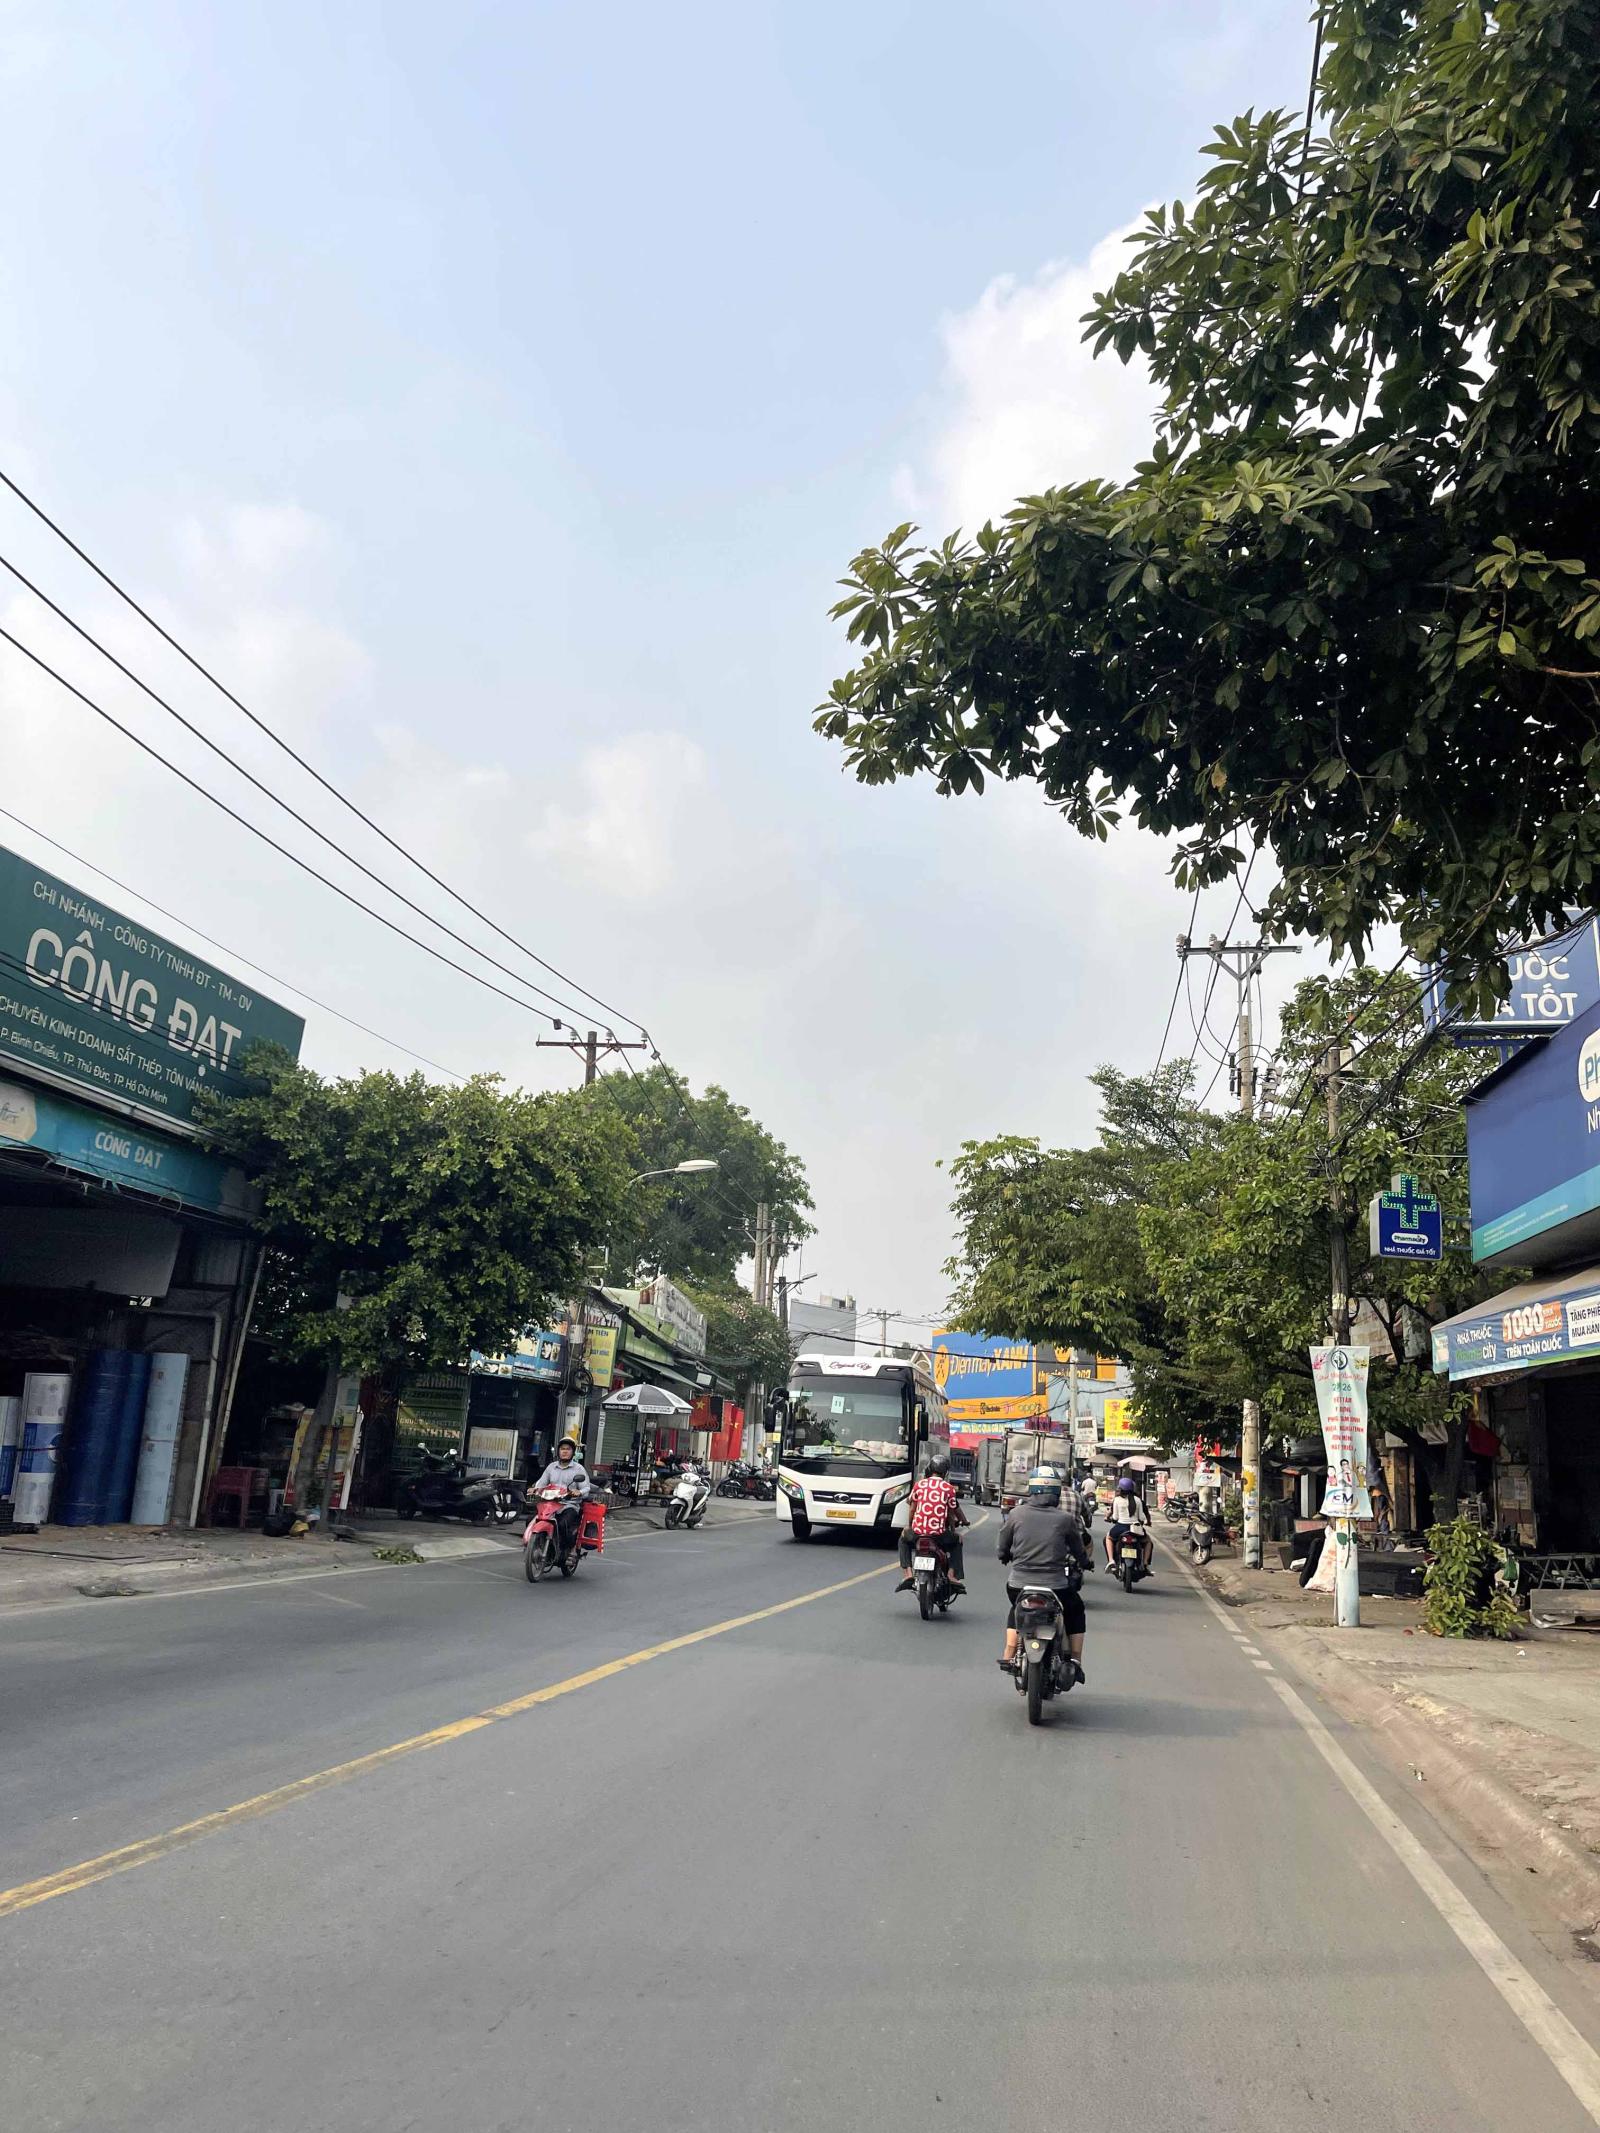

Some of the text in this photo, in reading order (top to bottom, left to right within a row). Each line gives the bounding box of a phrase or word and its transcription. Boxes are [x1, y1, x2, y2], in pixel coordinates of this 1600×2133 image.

[33, 881, 56, 905] CHI
[59, 895, 104, 931] NHÁNH
[114, 925, 147, 954] CÔNG
[150, 944, 164, 962] TY
[166, 953, 194, 981] TNHH
[196, 970, 211, 989] ĐT
[218, 982, 232, 1001] TM
[25, 928, 242, 1077] CÔNG ĐẠT
[1521, 982, 1578, 1018] TỐT
[49, 1017, 77, 1041] KINH
[78, 1030, 116, 1058] DOANH
[116, 1044, 136, 1065] SẮT
[137, 1055, 163, 1081] THÉP,
[165, 1067, 184, 1087] TÔN
[63, 1052, 75, 1067] TP.
[77, 1058, 92, 1074] Thủ
[94, 1065, 111, 1084] Đức,
[114, 1073, 124, 1087] TP.
[126, 1078, 137, 1092] Hồ
[137, 1083, 151, 1098] Chí
[150, 1088, 168, 1105] Minh
[95, 1131, 131, 1159] CÔNG
[1503, 1302, 1545, 1341] 1000
[992, 1344, 1029, 1371] XANH
[1506, 1333, 1563, 1358] TRÊN TOÀN QUỐC
